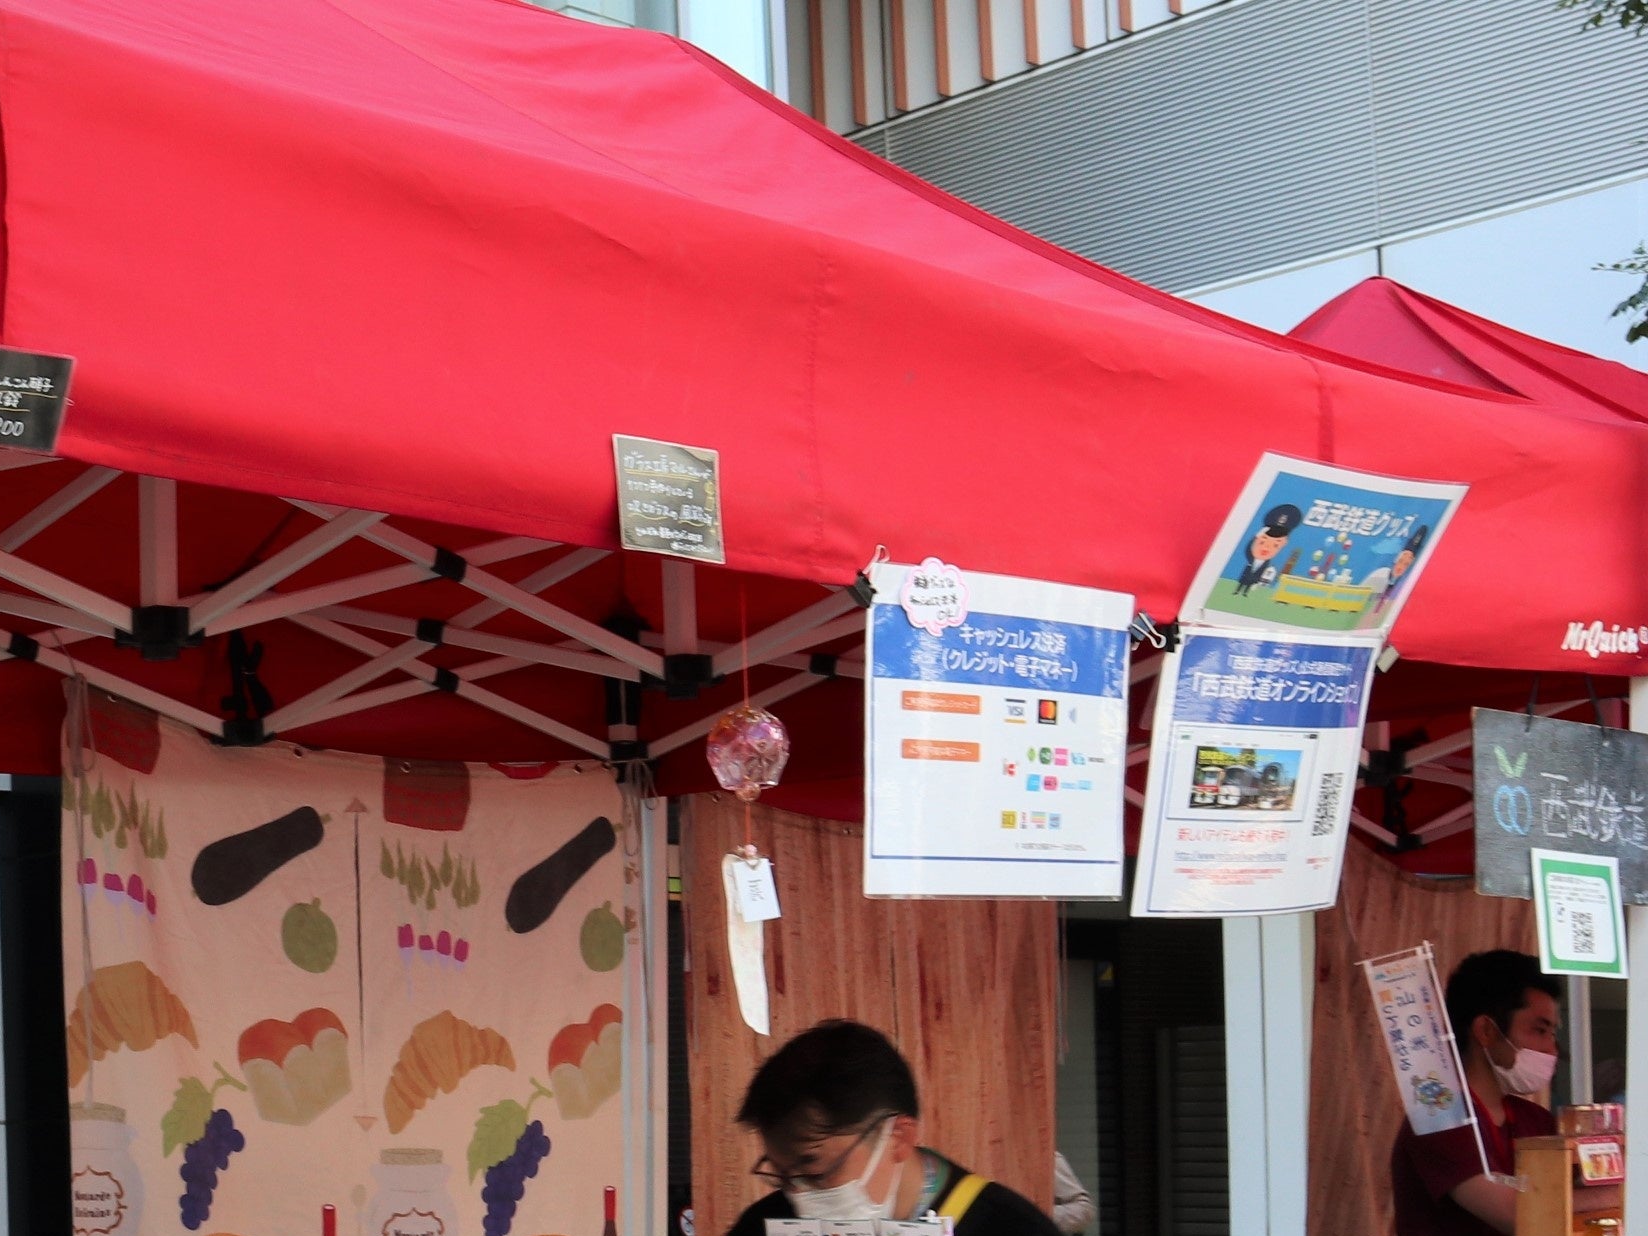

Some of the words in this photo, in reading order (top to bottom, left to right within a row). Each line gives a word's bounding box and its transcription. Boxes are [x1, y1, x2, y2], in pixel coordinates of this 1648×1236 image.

[1303, 499, 1419, 537] 西武鉄道グッズ
[958, 623, 1067, 655] キャッシュレス決済
